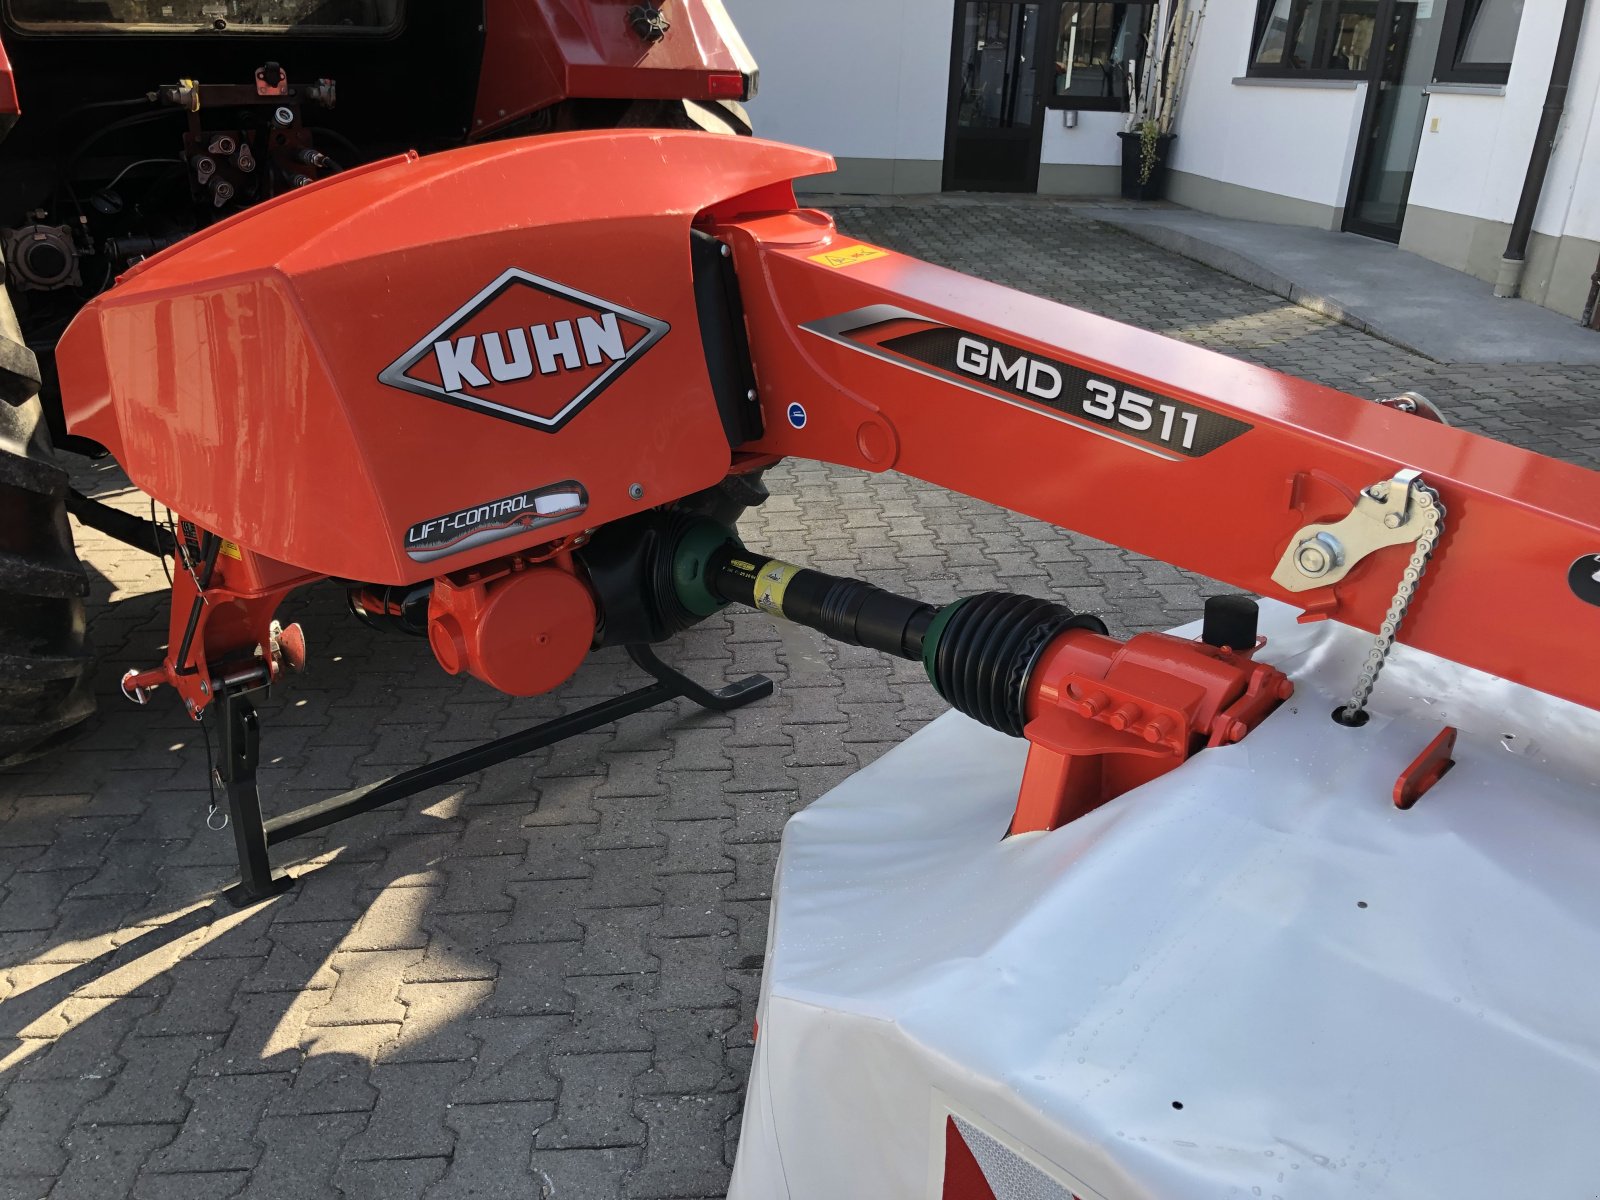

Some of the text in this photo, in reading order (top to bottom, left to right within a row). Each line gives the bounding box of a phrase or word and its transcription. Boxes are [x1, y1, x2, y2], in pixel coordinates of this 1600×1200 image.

[434, 312, 626, 392] KUHN
[956, 337, 1198, 449] GMD 3511
[409, 495, 533, 542] LIFT-CONTROL
